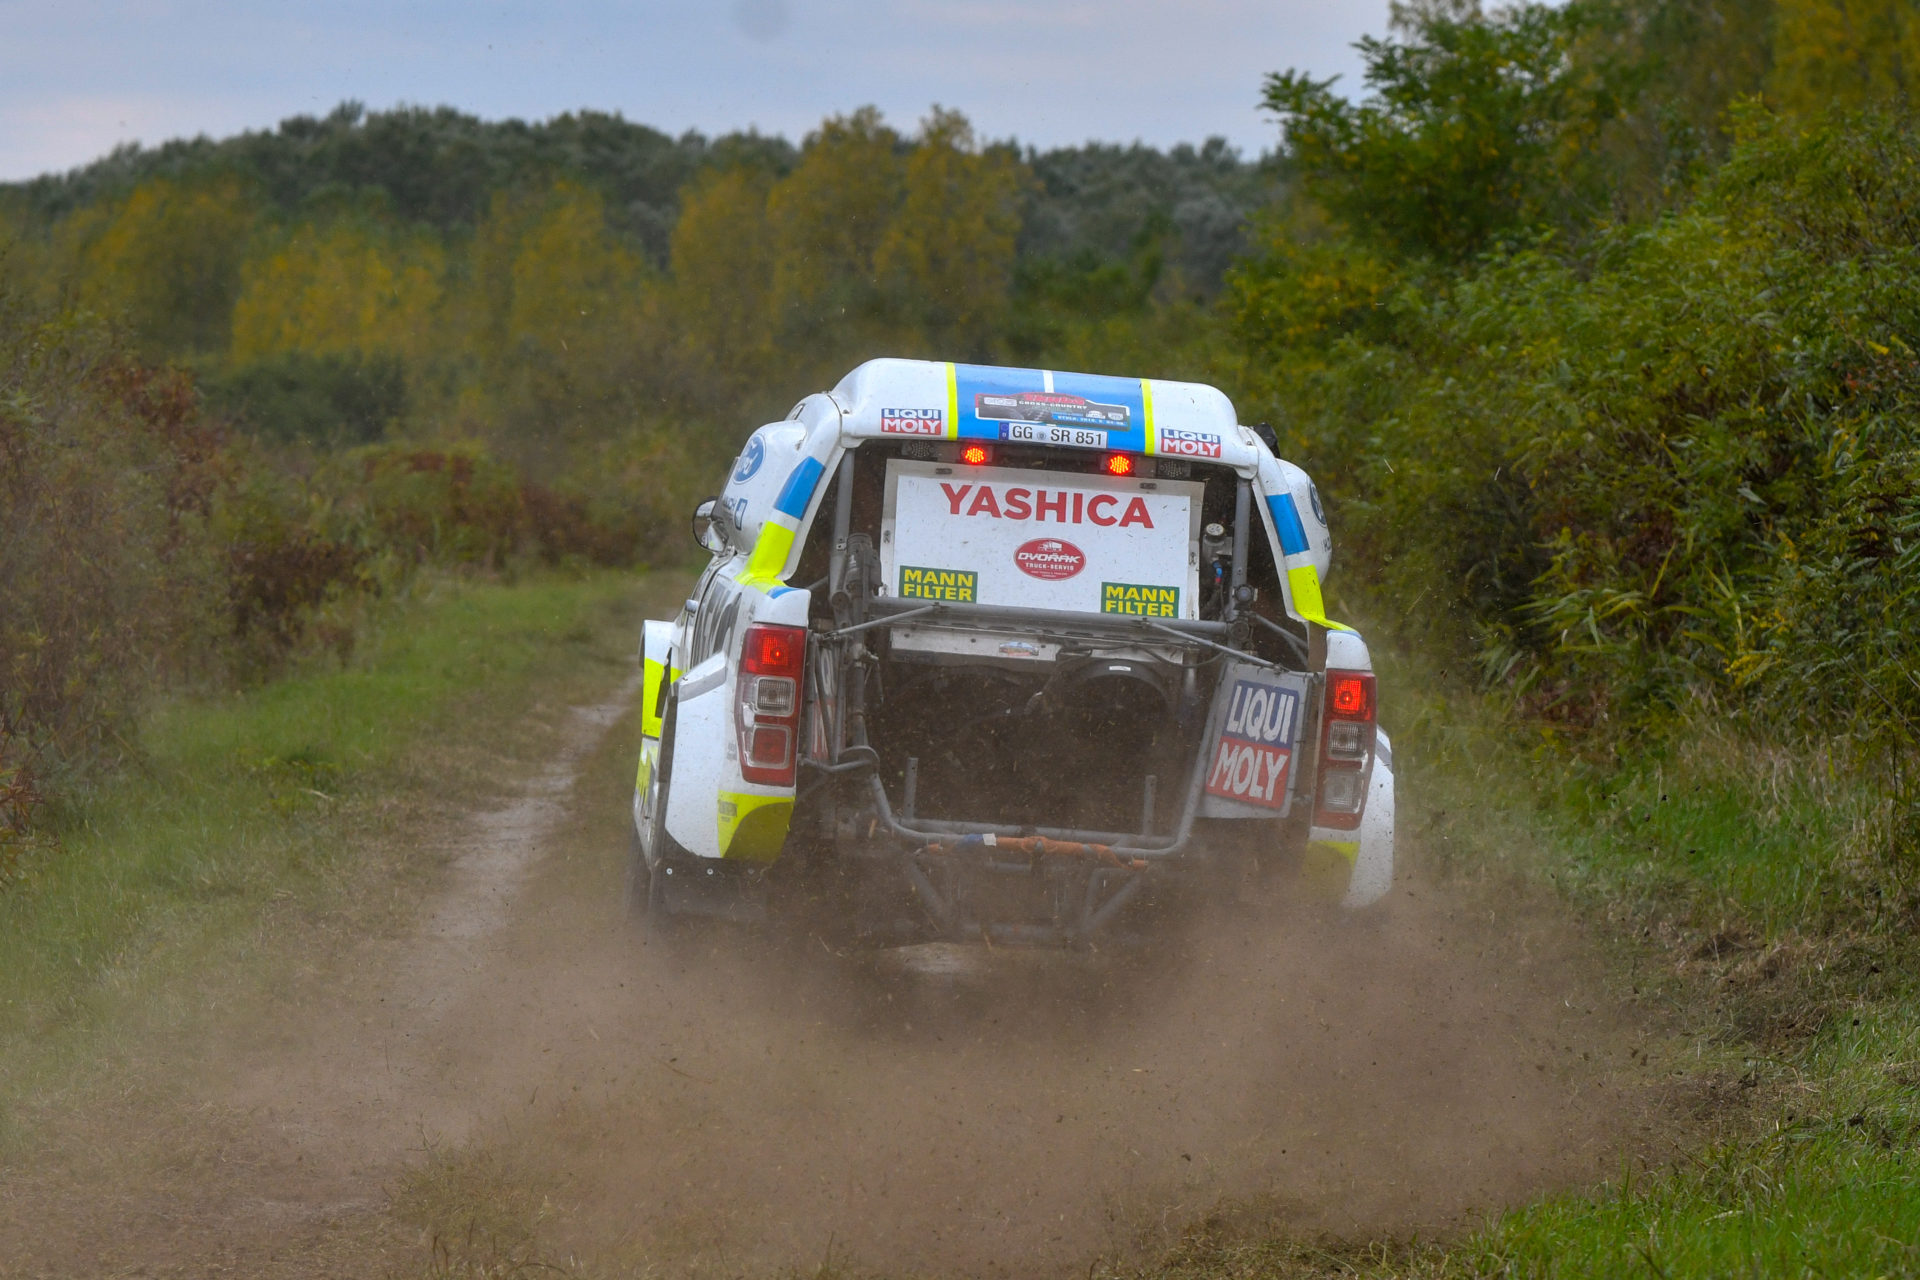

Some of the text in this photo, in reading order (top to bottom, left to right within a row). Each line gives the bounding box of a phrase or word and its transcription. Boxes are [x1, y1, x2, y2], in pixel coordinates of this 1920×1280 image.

[883, 409, 939, 419] LIQUI
[883, 418, 941, 434] MOLY
[1012, 425, 1102, 446] GG SR 851
[1163, 429, 1218, 443] LIQUI
[1163, 438, 1220, 457] MOLY
[940, 482, 1155, 529] YASHICA
[903, 568, 974, 587] MANN
[903, 583, 973, 601] FILTER
[1105, 585, 1175, 603] MANN
[1105, 599, 1174, 617] FILTER
[1226, 685, 1295, 744] LIQUI
[1209, 741, 1289, 801] MOLY
